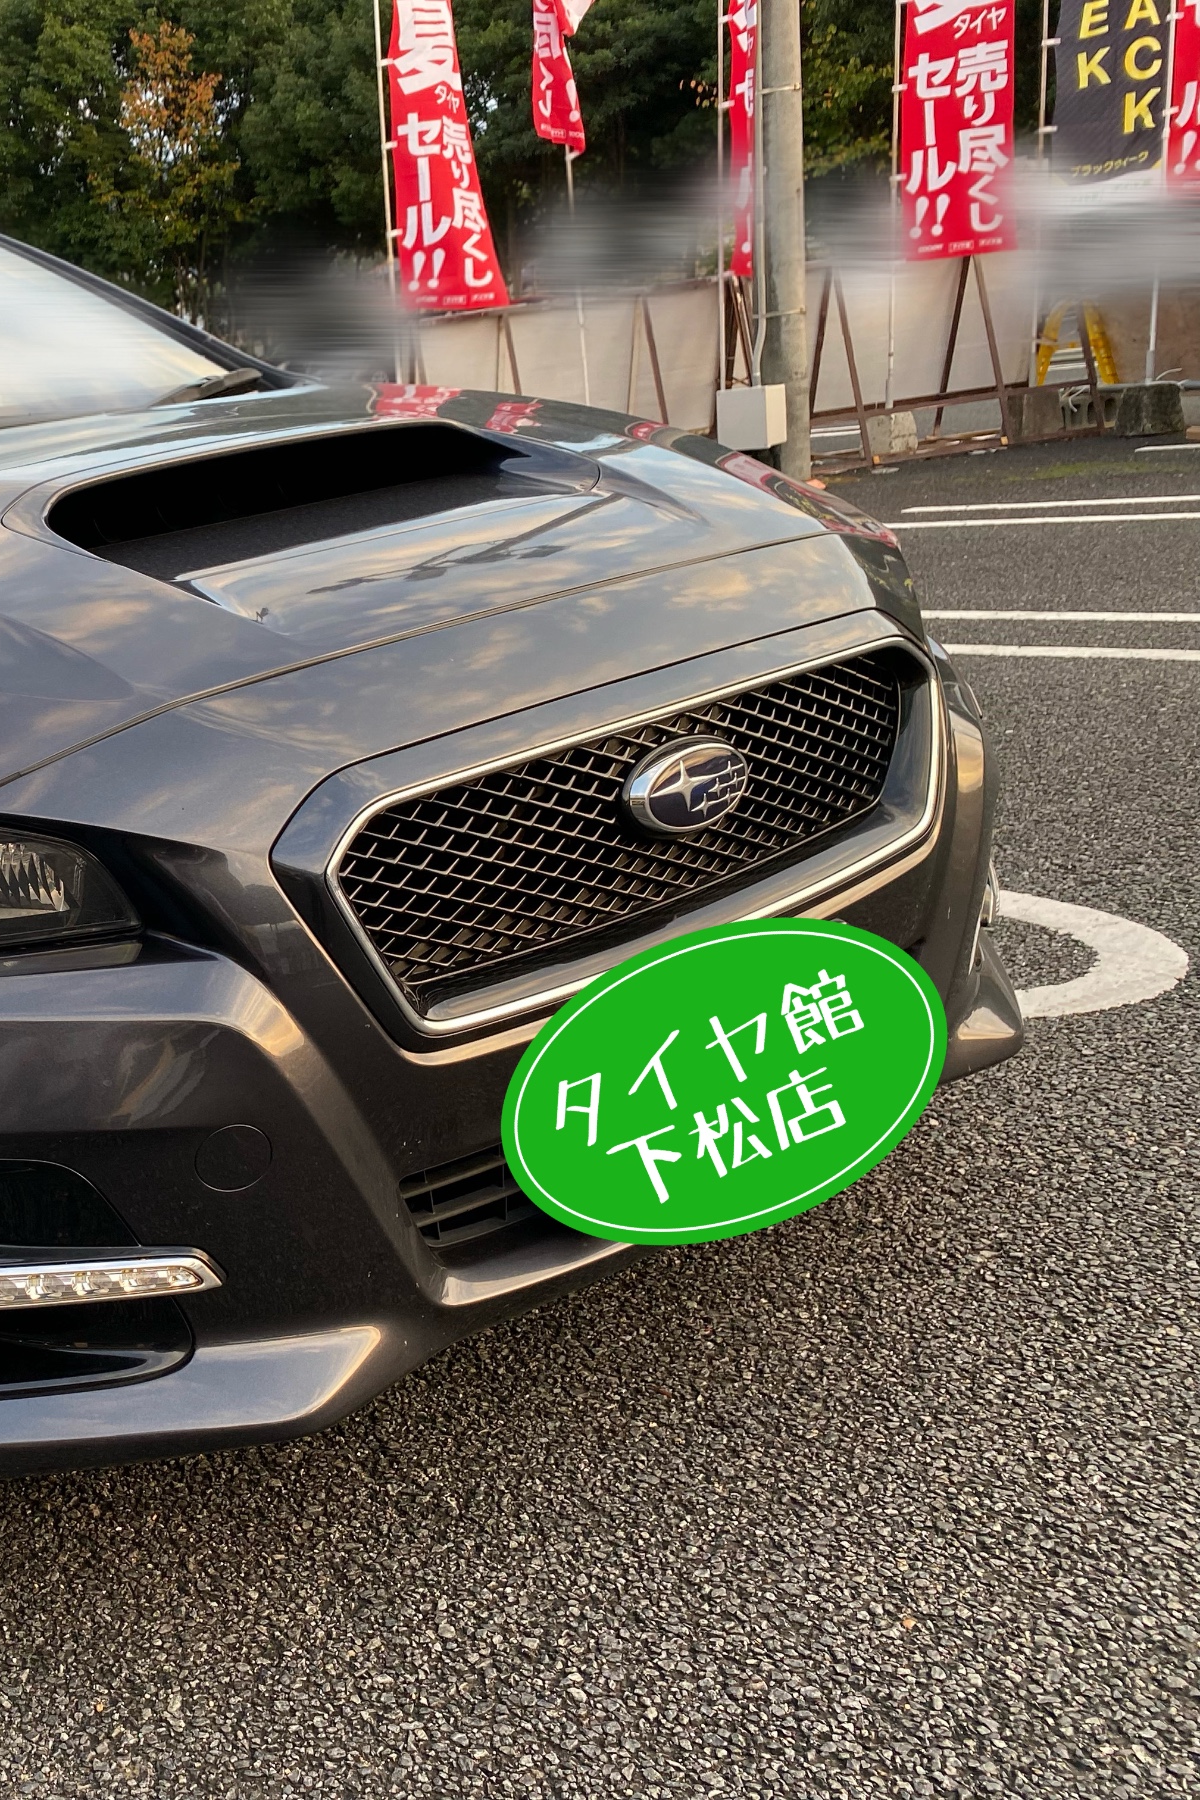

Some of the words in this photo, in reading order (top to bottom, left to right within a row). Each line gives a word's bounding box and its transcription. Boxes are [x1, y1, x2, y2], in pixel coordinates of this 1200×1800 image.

[953, 6, 1008, 40] タイヤ
[442, 115, 493, 288] 売り尽くし
[954, 39, 1010, 233] 売り尽くし
